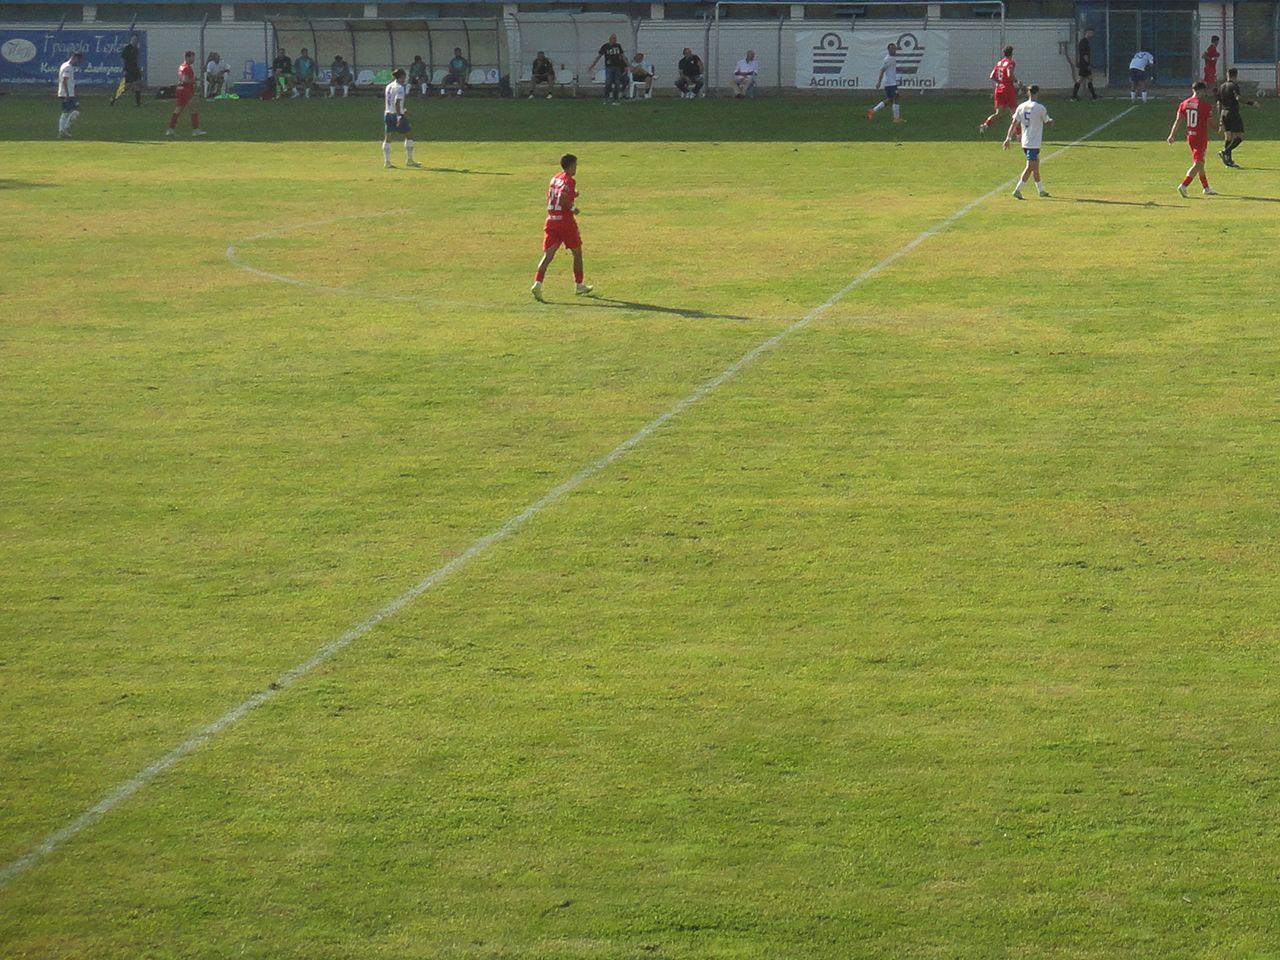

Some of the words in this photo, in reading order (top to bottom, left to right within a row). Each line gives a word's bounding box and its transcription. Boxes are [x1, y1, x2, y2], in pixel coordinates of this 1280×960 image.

[809, 76, 859, 88] Admiral
[897, 76, 936, 88] dmiral
[1024, 112, 1031, 129] 5
[1186, 109, 1198, 128] 10
